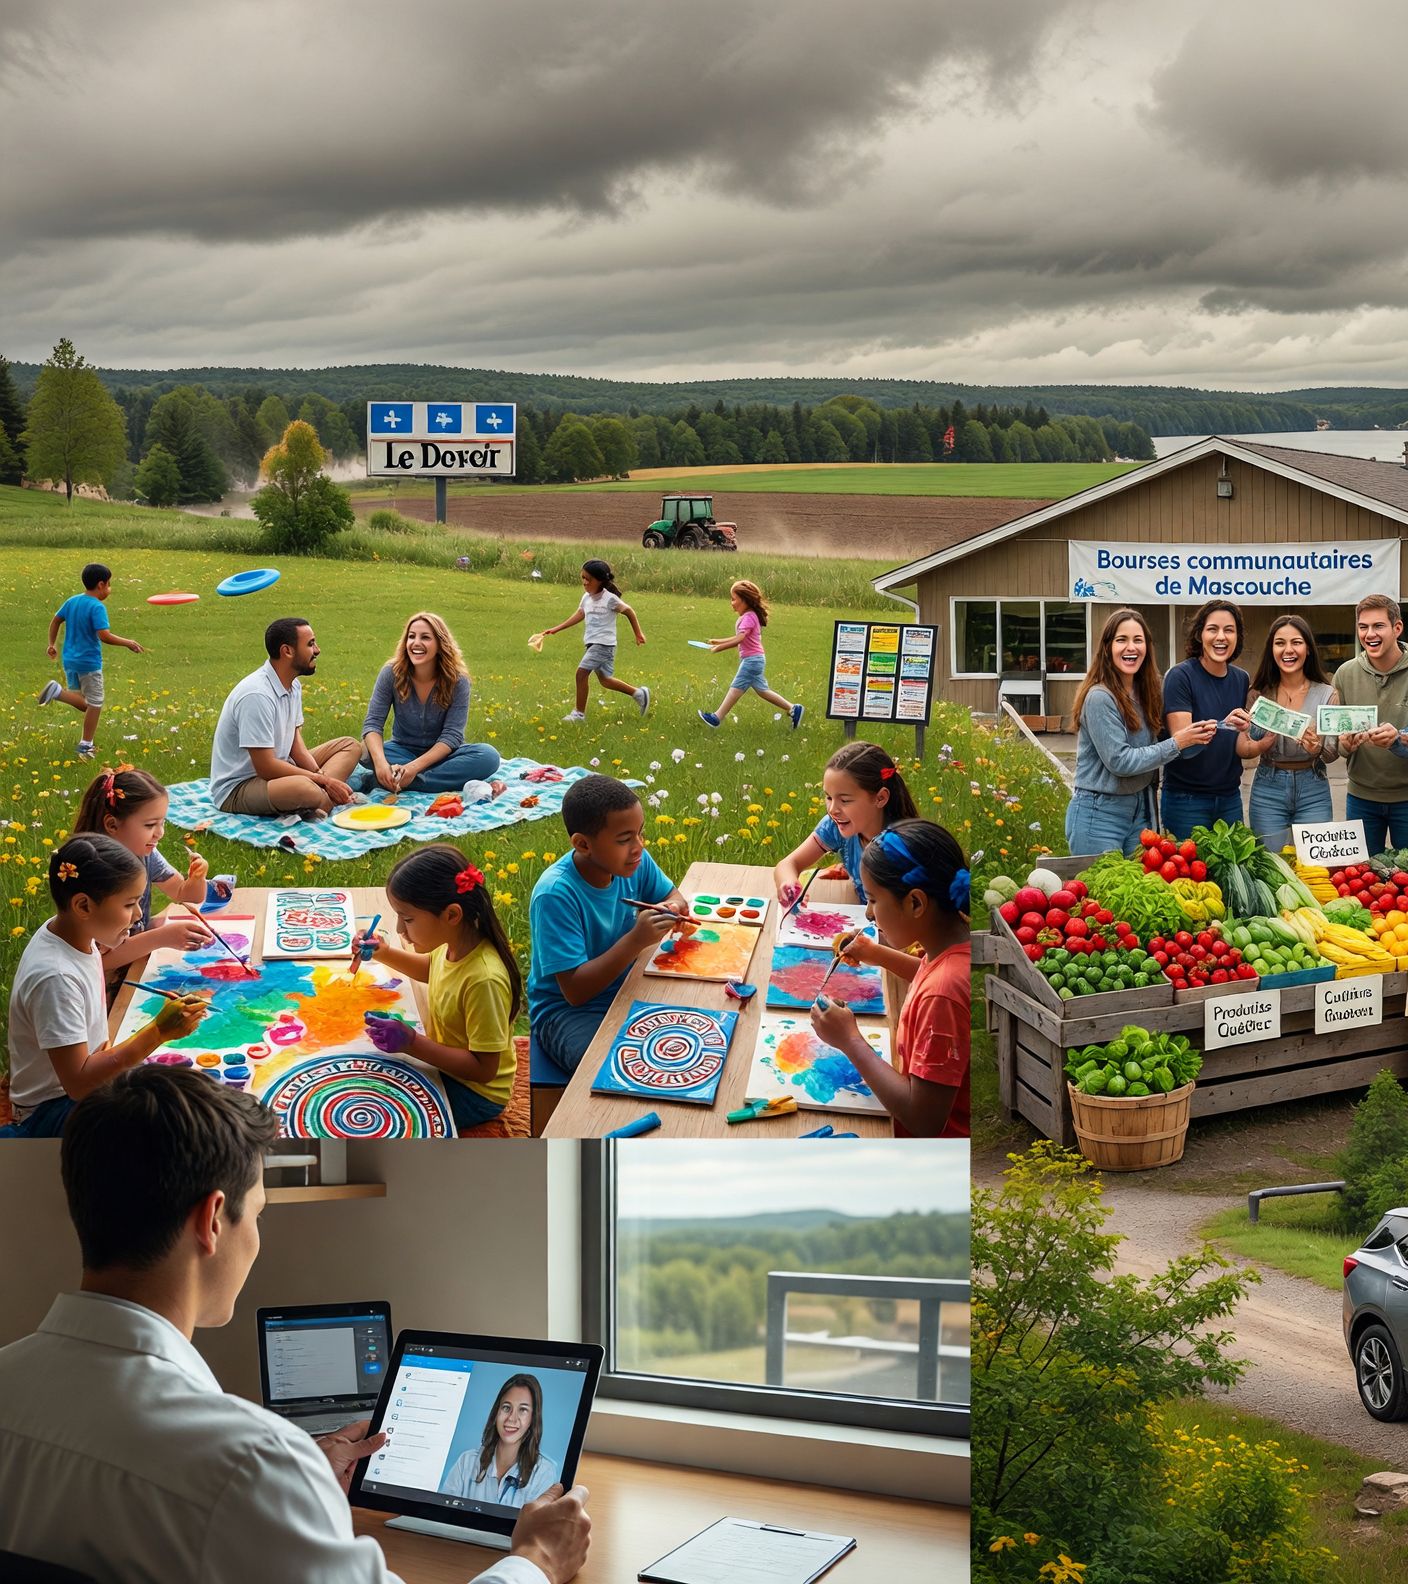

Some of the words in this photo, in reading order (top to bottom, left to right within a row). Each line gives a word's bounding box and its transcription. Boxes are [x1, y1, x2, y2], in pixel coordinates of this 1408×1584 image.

[384, 442, 414, 469] Le
[1097, 549, 1181, 570] Bourses
[1187, 547, 1373, 571] communautaires
[1155, 576, 1182, 596] de
[1189, 576, 1312, 596] Mascouche
